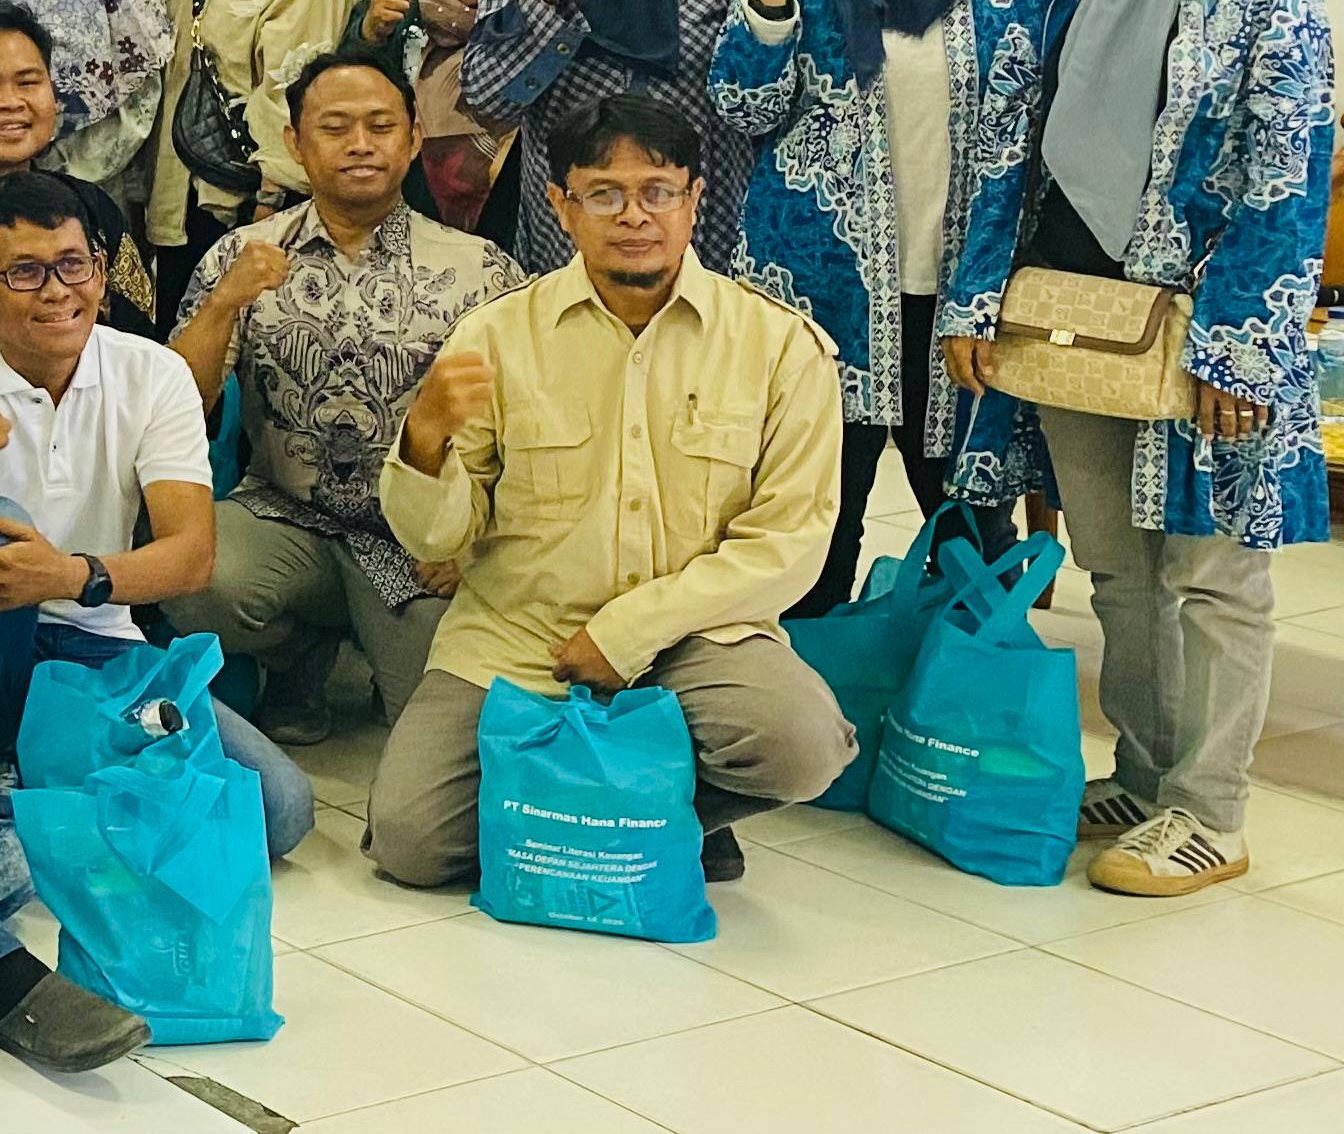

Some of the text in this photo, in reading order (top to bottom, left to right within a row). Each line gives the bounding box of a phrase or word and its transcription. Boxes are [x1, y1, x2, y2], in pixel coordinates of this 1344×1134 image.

[927, 737, 980, 758] Finance
[503, 799, 521, 812] PT
[522, 803, 578, 824] Sinarmas
[580, 815, 616, 828] Hana
